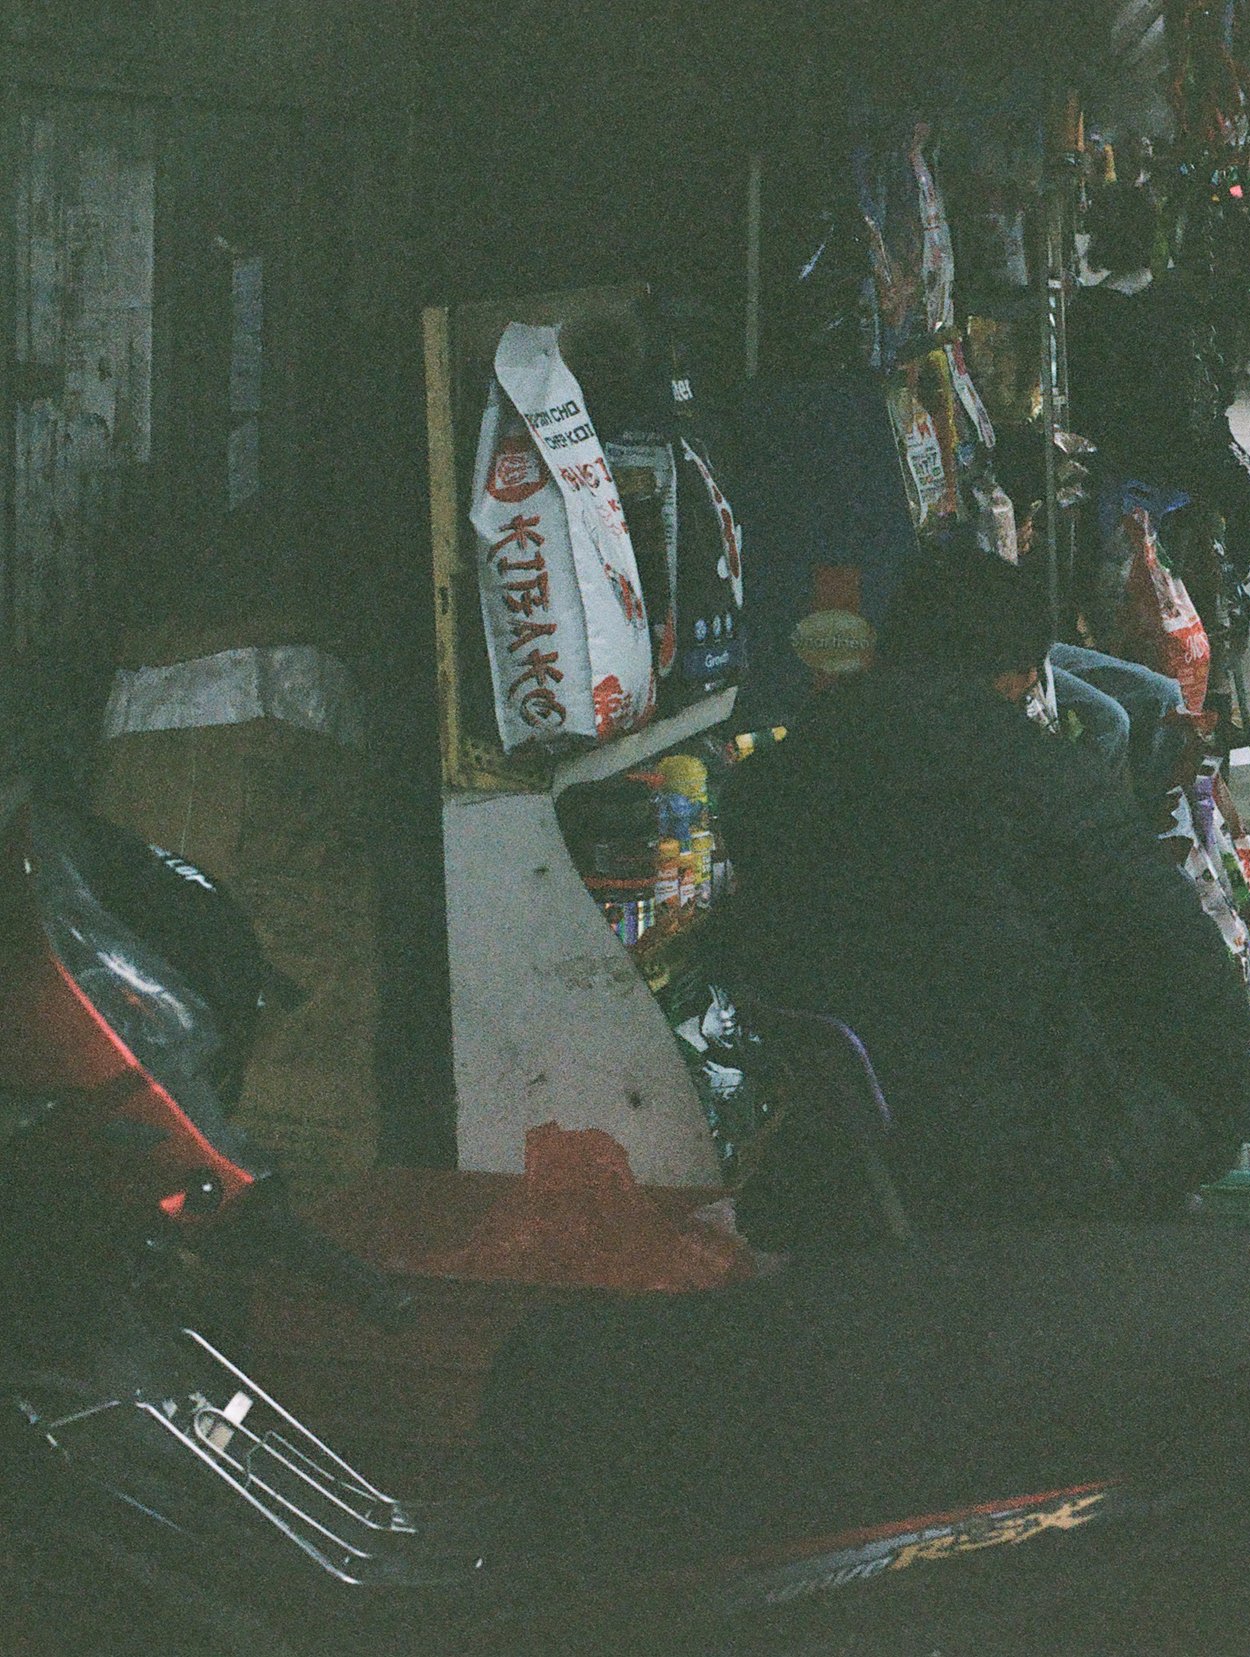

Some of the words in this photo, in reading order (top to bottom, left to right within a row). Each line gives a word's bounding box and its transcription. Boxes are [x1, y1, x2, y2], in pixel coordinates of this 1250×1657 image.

[549, 400, 581, 422] CHO
[565, 423, 595, 445] KOI
[487, 514, 567, 727] KIBAKO
